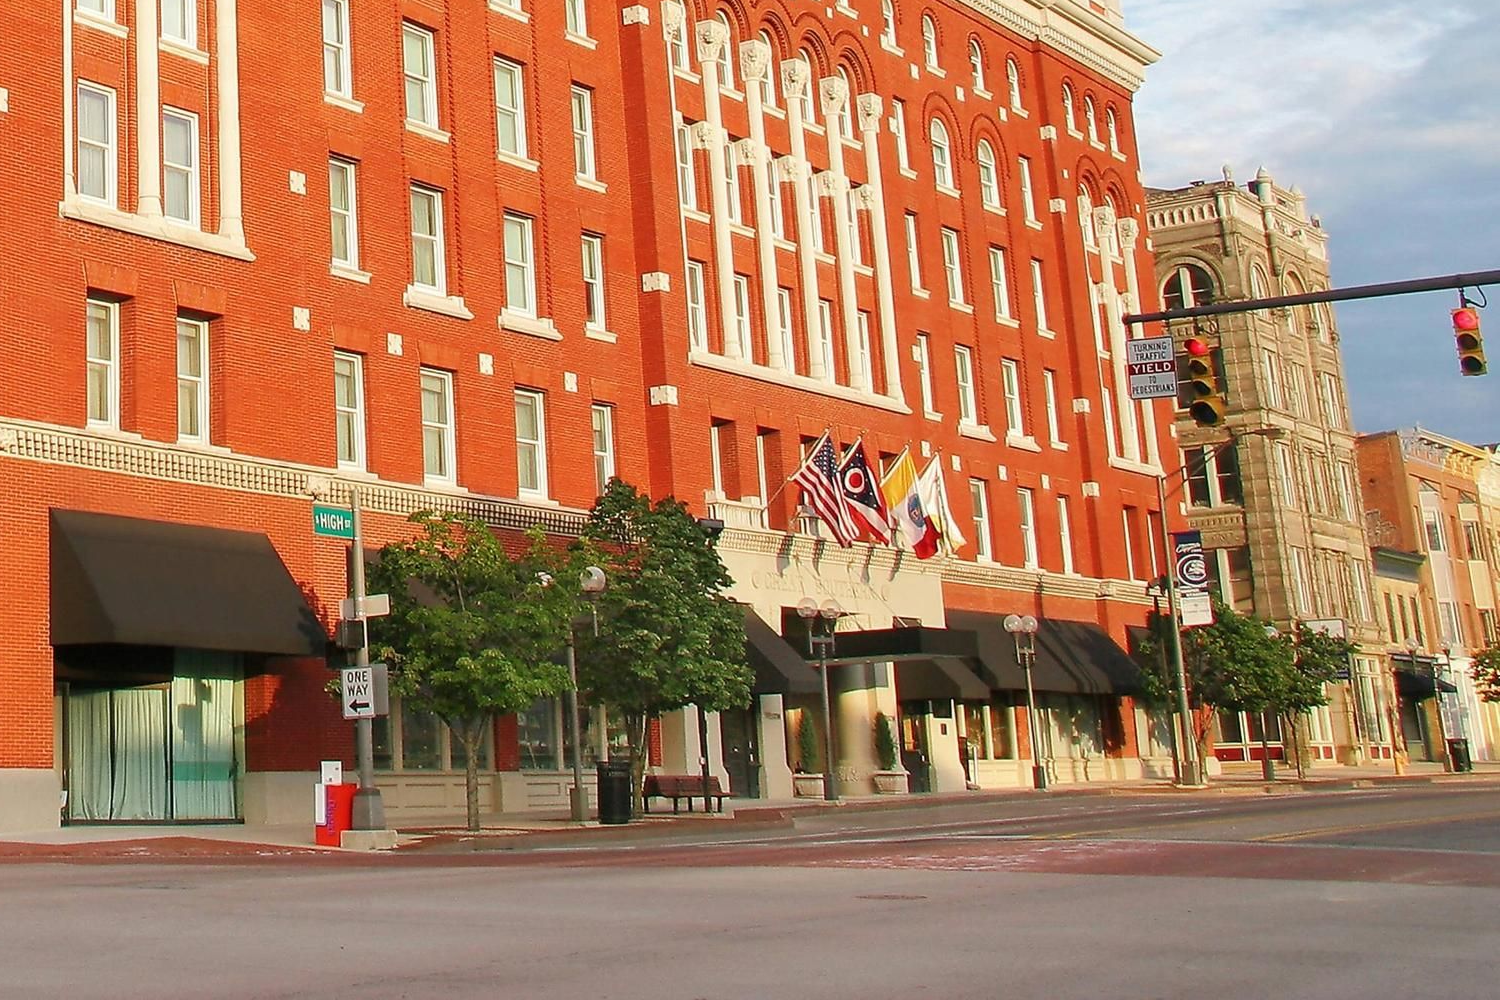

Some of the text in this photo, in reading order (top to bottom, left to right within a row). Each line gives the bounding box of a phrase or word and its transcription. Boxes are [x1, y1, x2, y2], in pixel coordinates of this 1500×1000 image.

[1133, 341, 1167, 352] TURNING
[1135, 351, 1166, 361] TRAFFIC
[1132, 362, 1172, 374] YIELD
[1148, 375, 1157, 384] TO
[1132, 383, 1175, 395] PEDESTRIANS
[320, 511, 344, 531] HIGH
[347, 671, 368, 683] ONE
[347, 684, 368, 697] WAY
